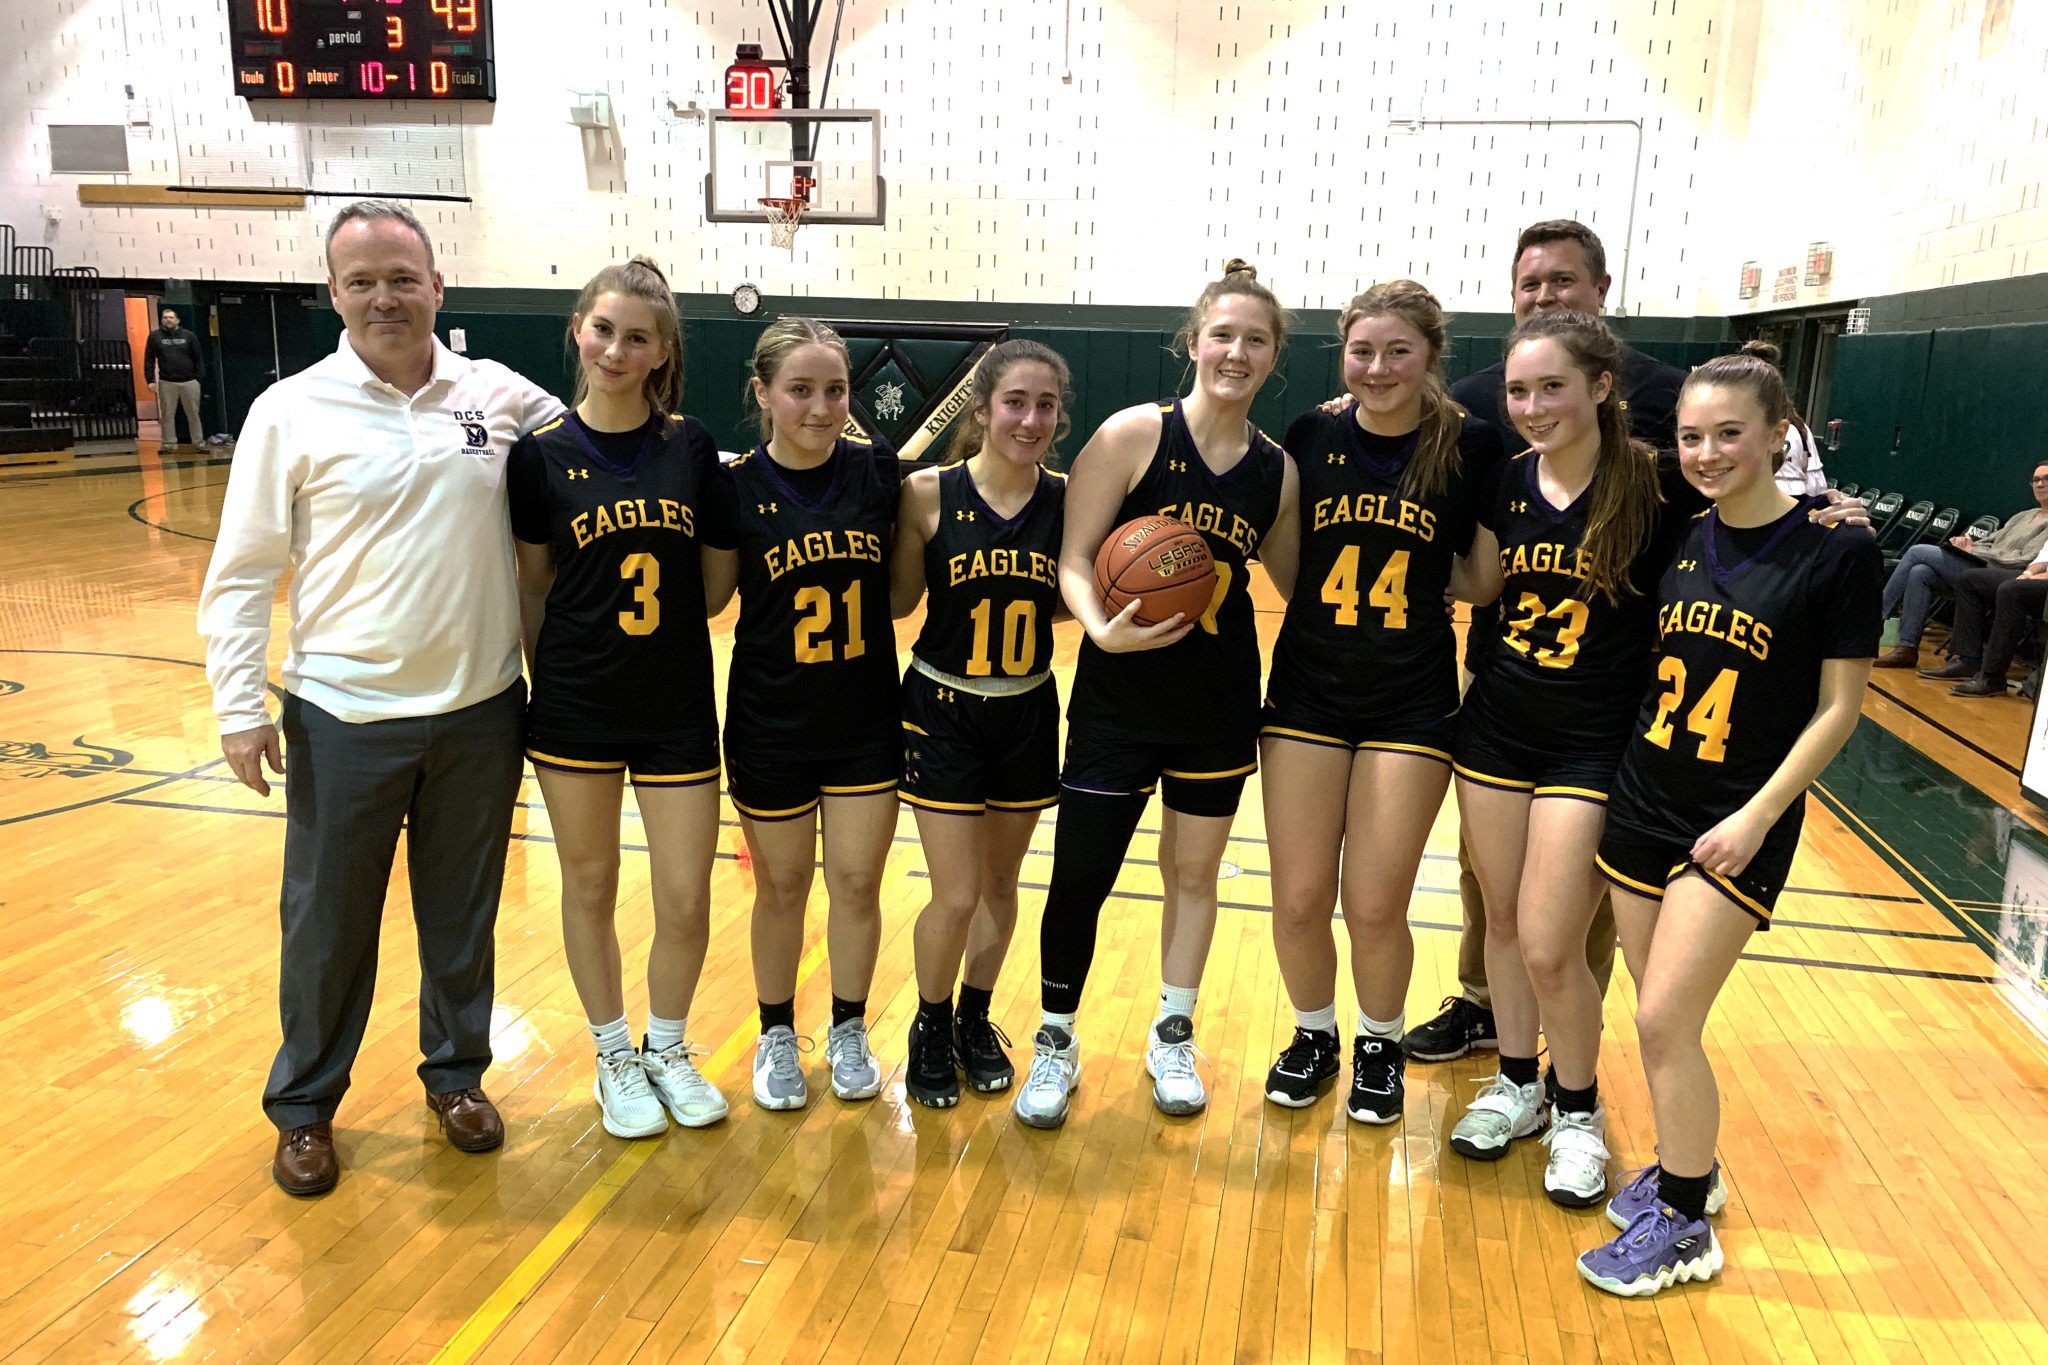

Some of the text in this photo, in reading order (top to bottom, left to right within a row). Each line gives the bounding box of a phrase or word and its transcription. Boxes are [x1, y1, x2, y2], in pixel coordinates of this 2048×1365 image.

[329, 16, 403, 48] period 3
[241, 62, 294, 93] fouls 0
[307, 70, 339, 83] player
[431, 62, 475, 92] 0 fouls
[727, 72, 769, 109] 30
[454, 411, 485, 420] DCS
[461, 448, 495, 456] BASKETBALL
[571, 499, 695, 549] EAGLES
[1314, 494, 1436, 542] EAGLES
[764, 530, 881, 581] EAGLES
[949, 549, 1057, 588] EAGLES
[1147, 542, 1206, 570] LEGACY
[1500, 543, 1608, 590] EAGLE
[619, 553, 660, 636] 3
[1320, 544, 1410, 630] 44
[794, 579, 865, 664] 21
[966, 598, 1037, 676] 10
[1503, 591, 1590, 669] 23
[1659, 601, 1773, 660] EAGLES
[1644, 656, 1739, 763] 24
